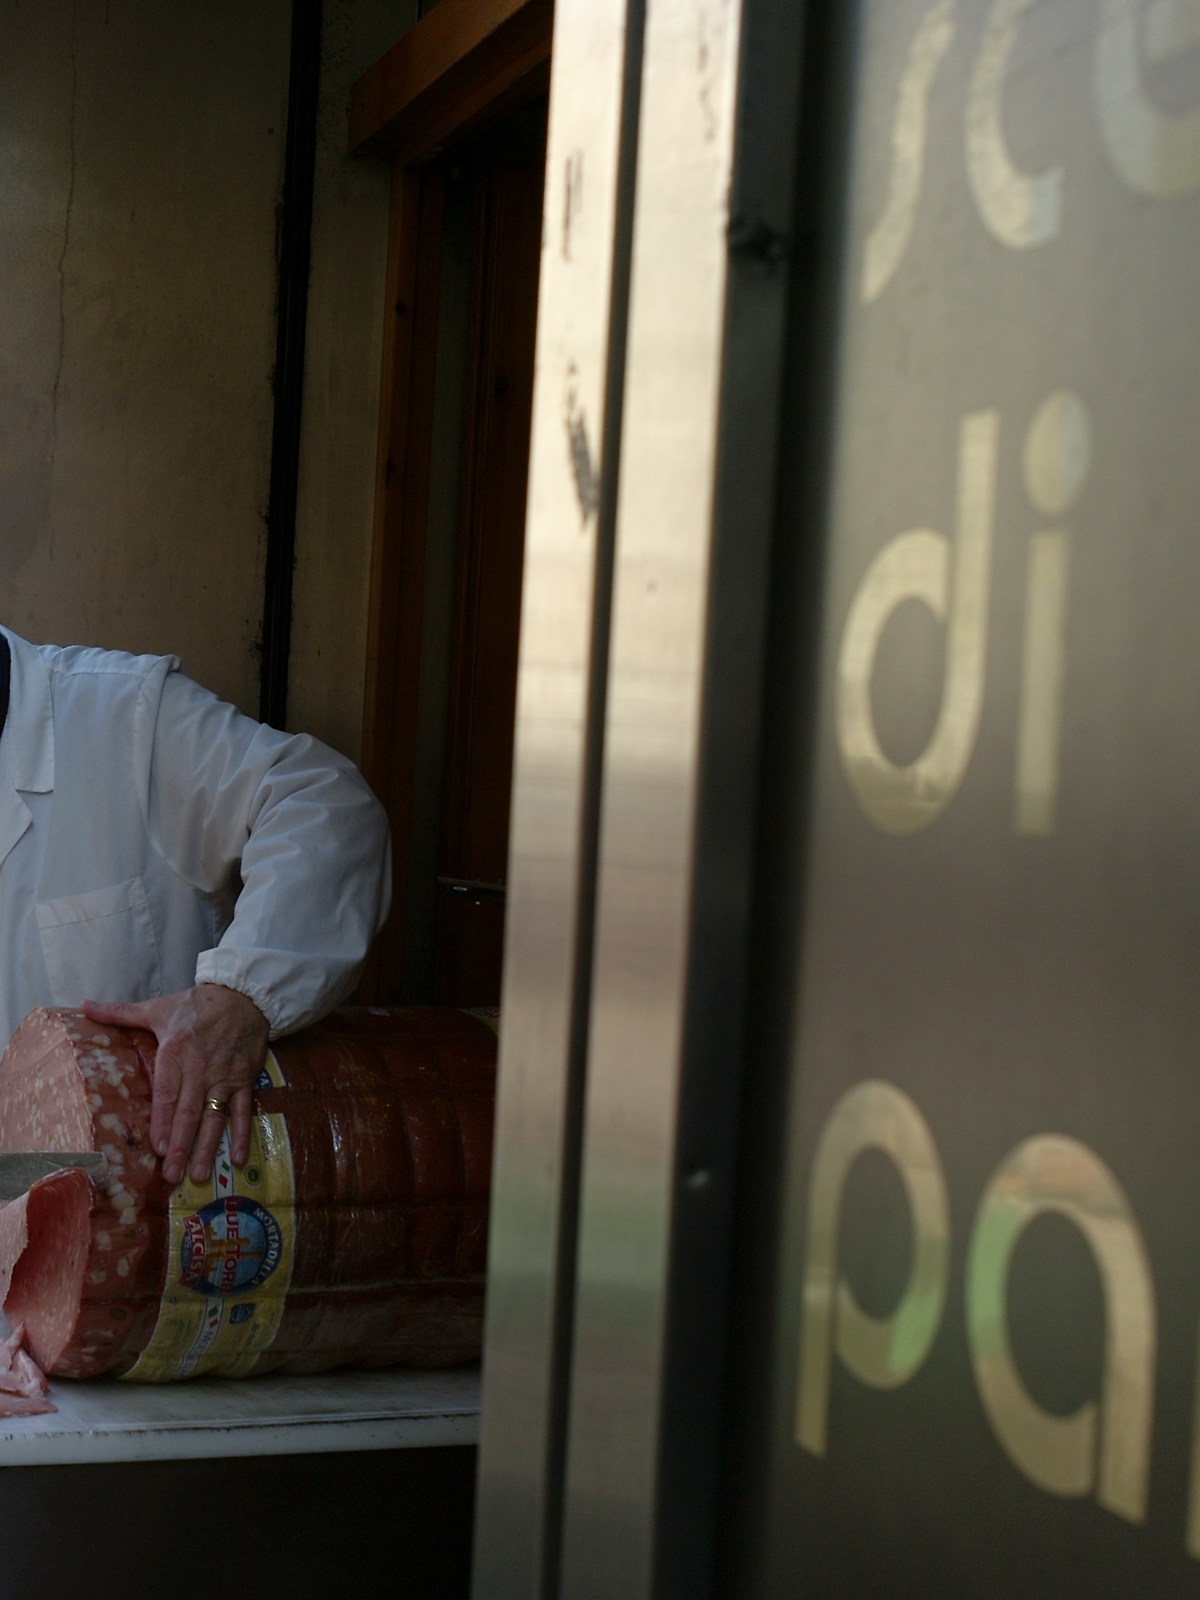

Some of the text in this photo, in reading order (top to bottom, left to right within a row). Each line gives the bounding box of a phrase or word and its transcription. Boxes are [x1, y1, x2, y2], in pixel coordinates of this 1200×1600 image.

[836, 390, 1093, 836] di
[184, 1220, 205, 1281] ALCISA
[224, 1198, 241, 1240] DUE
[251, 1206, 280, 1286] MORTADELLA
[795, 1078, 1200, 1562] pa
